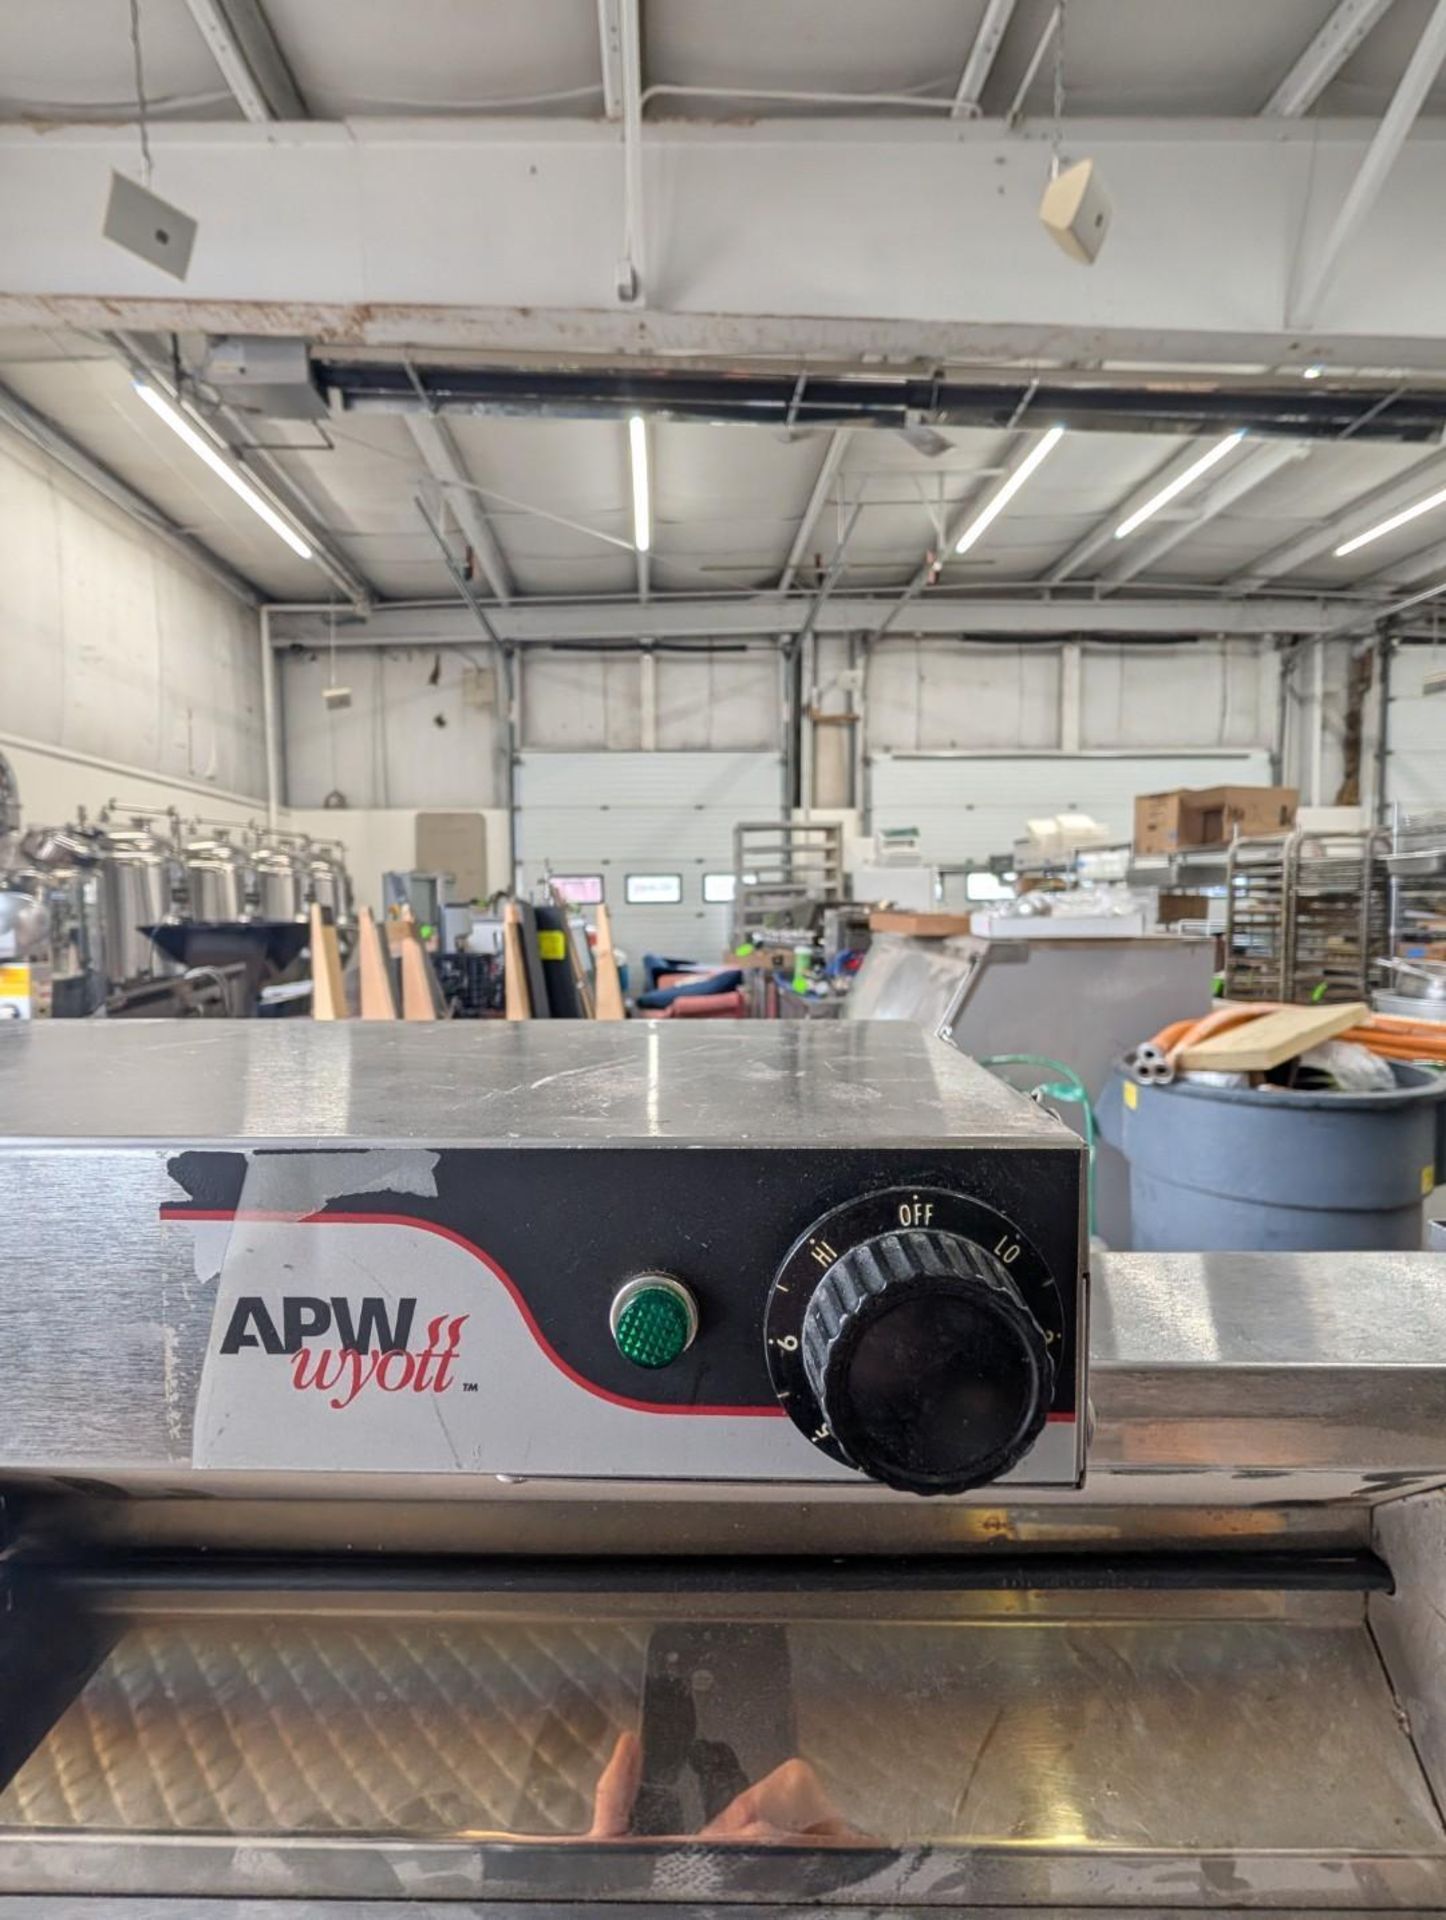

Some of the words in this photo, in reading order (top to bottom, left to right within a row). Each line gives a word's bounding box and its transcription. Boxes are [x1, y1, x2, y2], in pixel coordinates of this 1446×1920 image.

[899, 1204, 934, 1227] OFF
[810, 1241, 838, 1268] HI
[994, 1235, 1021, 1264] LO
[219, 1296, 418, 1356] APW
[776, 1335, 799, 1351] 6
[290, 1314, 471, 1410] wyott
